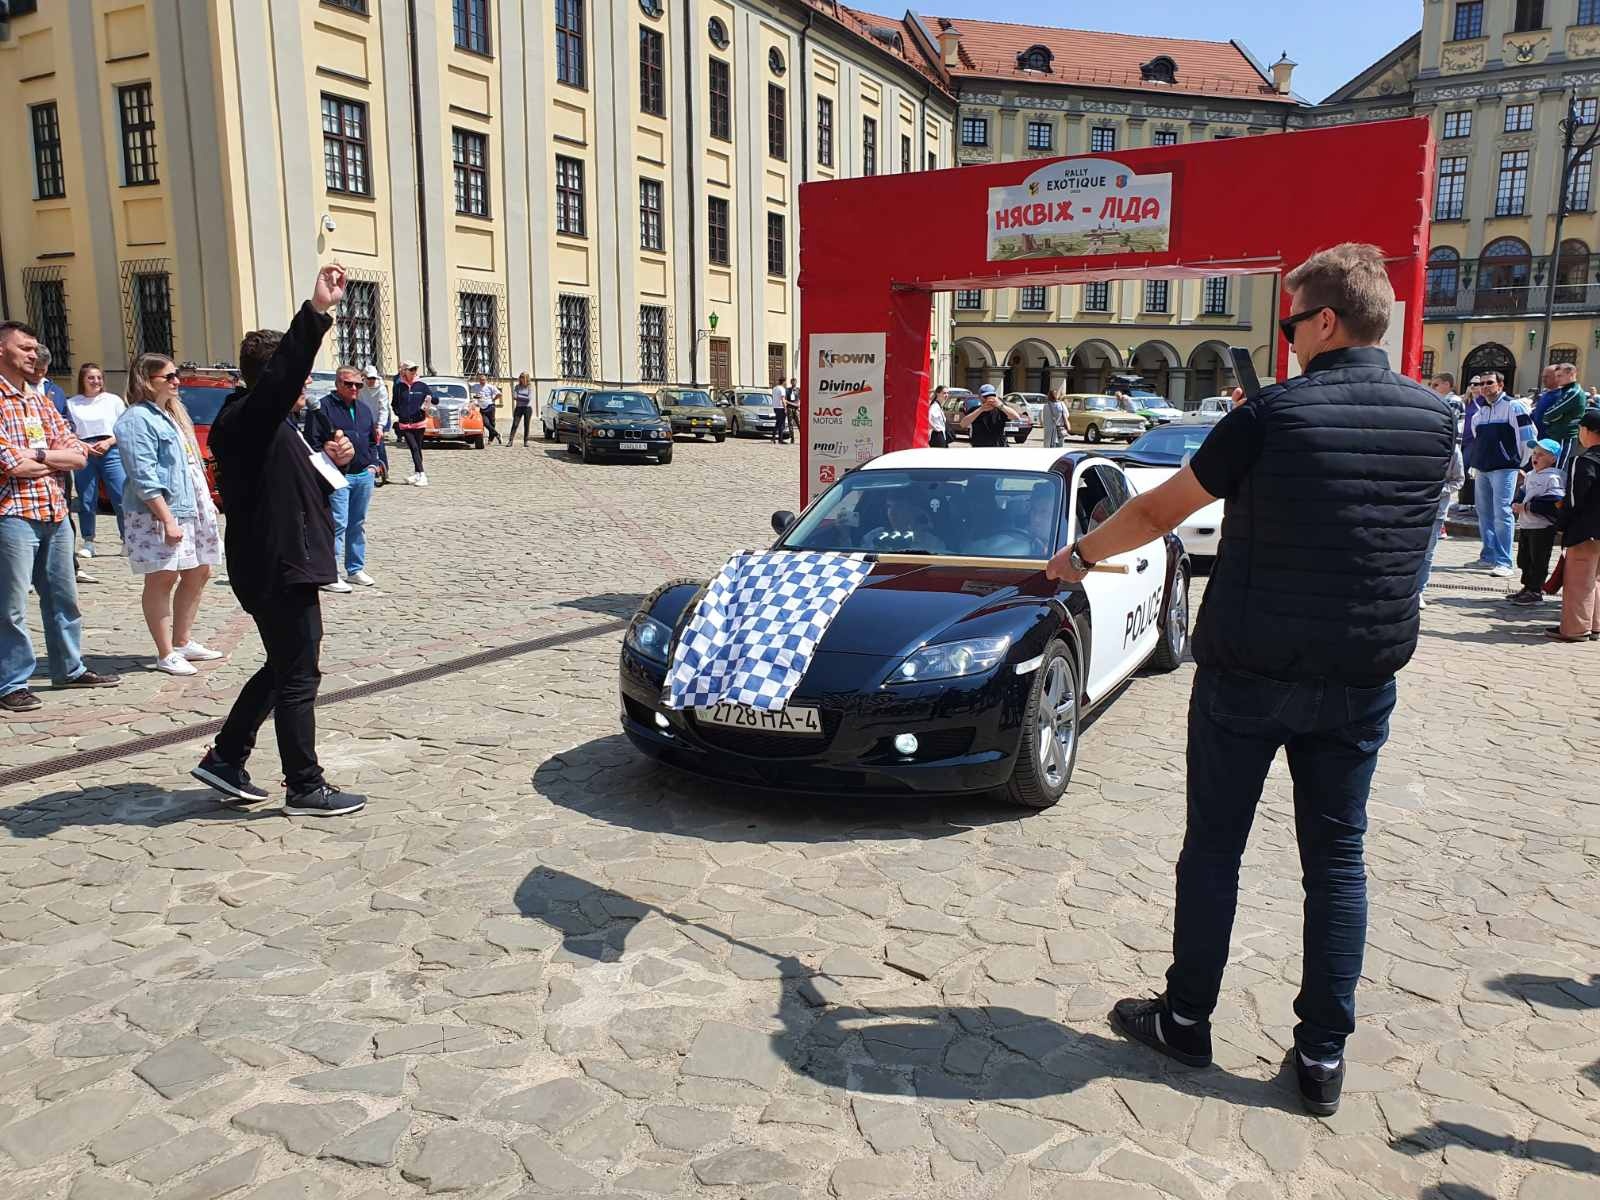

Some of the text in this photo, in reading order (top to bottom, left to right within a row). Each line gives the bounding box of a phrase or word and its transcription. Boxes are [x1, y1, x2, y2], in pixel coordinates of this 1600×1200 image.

[1064, 168, 1089, 177] RALLY
[1047, 176, 1106, 190] EXOTIQUE
[995, 200, 1074, 230] НЯСВІЖ
[1099, 196, 1160, 223] ЛІДА
[818, 350, 875, 368] KROWN
[819, 380, 866, 393] Divinol
[813, 407, 843, 417] JAC
[813, 417, 844, 425] MOTORS
[1122, 585, 1162, 650] POLICE
